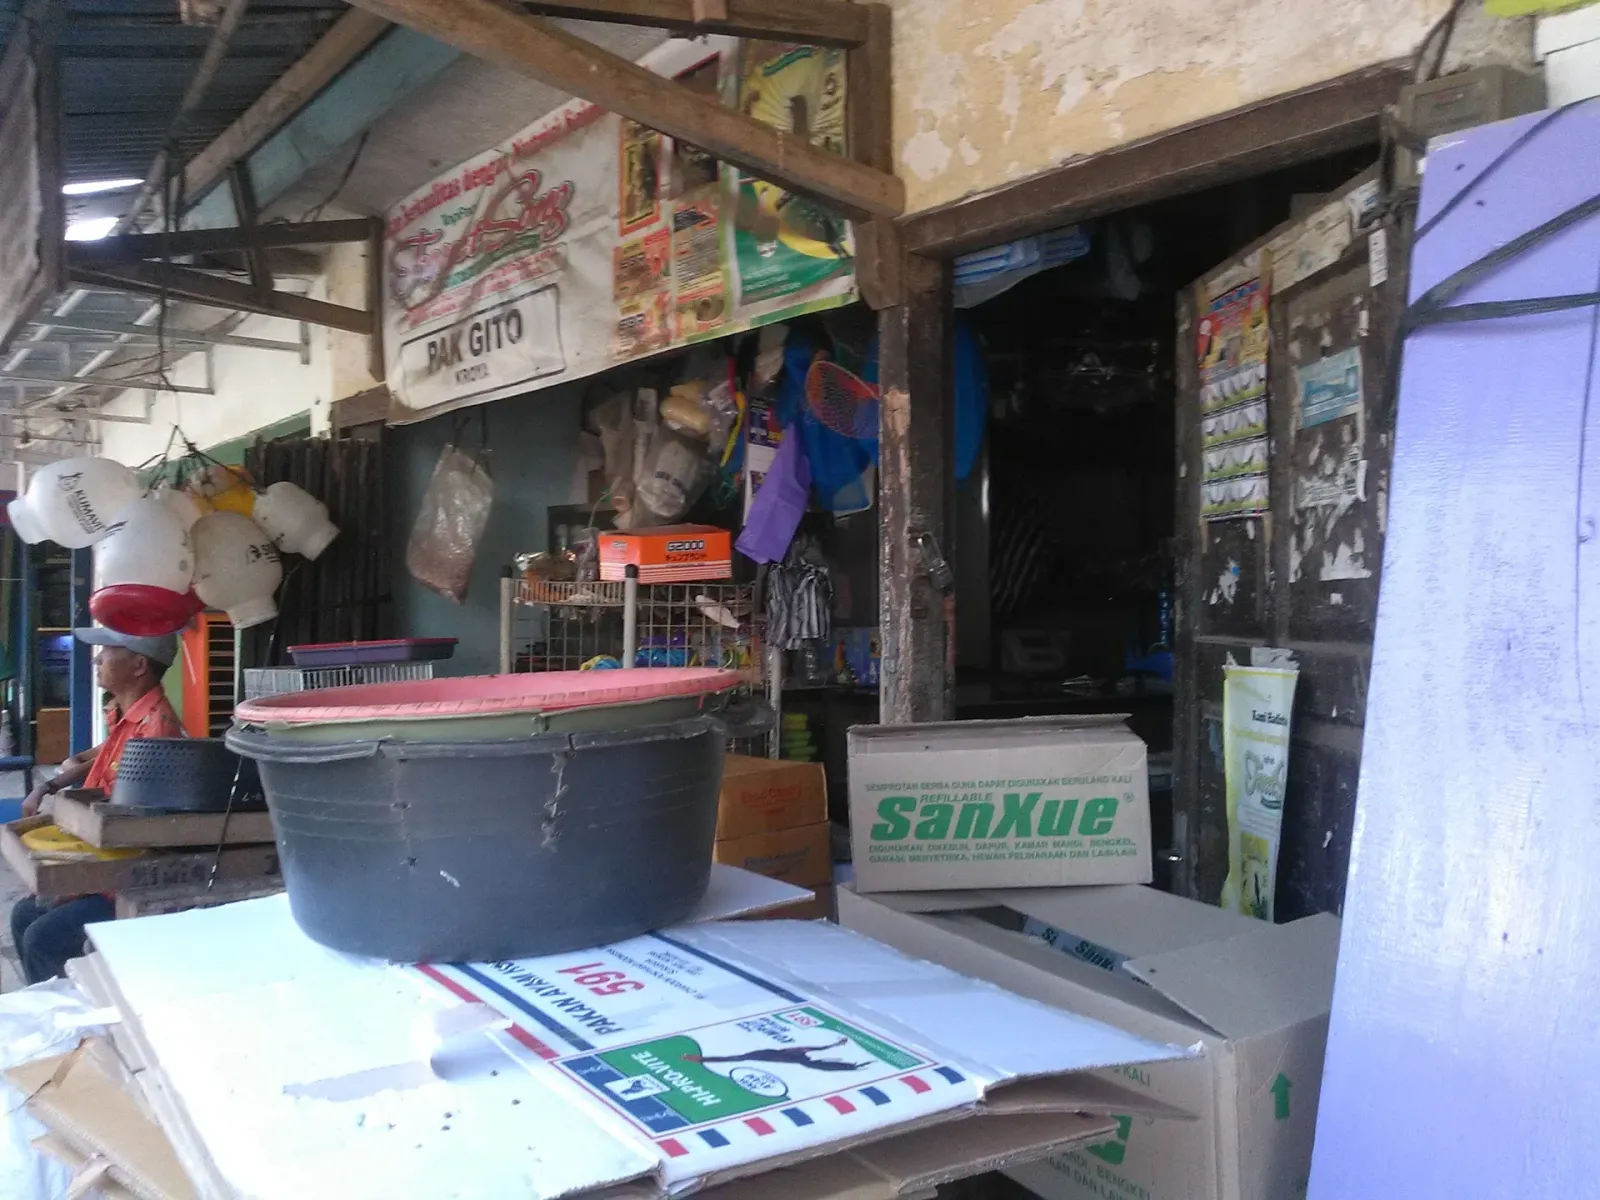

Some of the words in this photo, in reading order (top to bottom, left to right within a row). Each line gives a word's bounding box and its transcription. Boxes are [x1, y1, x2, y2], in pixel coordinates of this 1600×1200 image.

[427, 330, 463, 375] PAK
[469, 308, 523, 357] GITO
[1110, 774, 1132, 784] KALI
[920, 792, 993, 803] REFILLABLE
[869, 791, 1119, 841] SanXue
[509, 972, 567, 998] AYAM
[556, 961, 646, 997] 591
[550, 997, 625, 1036] PAKAN
[1123, 1064, 1151, 1087] KALI
